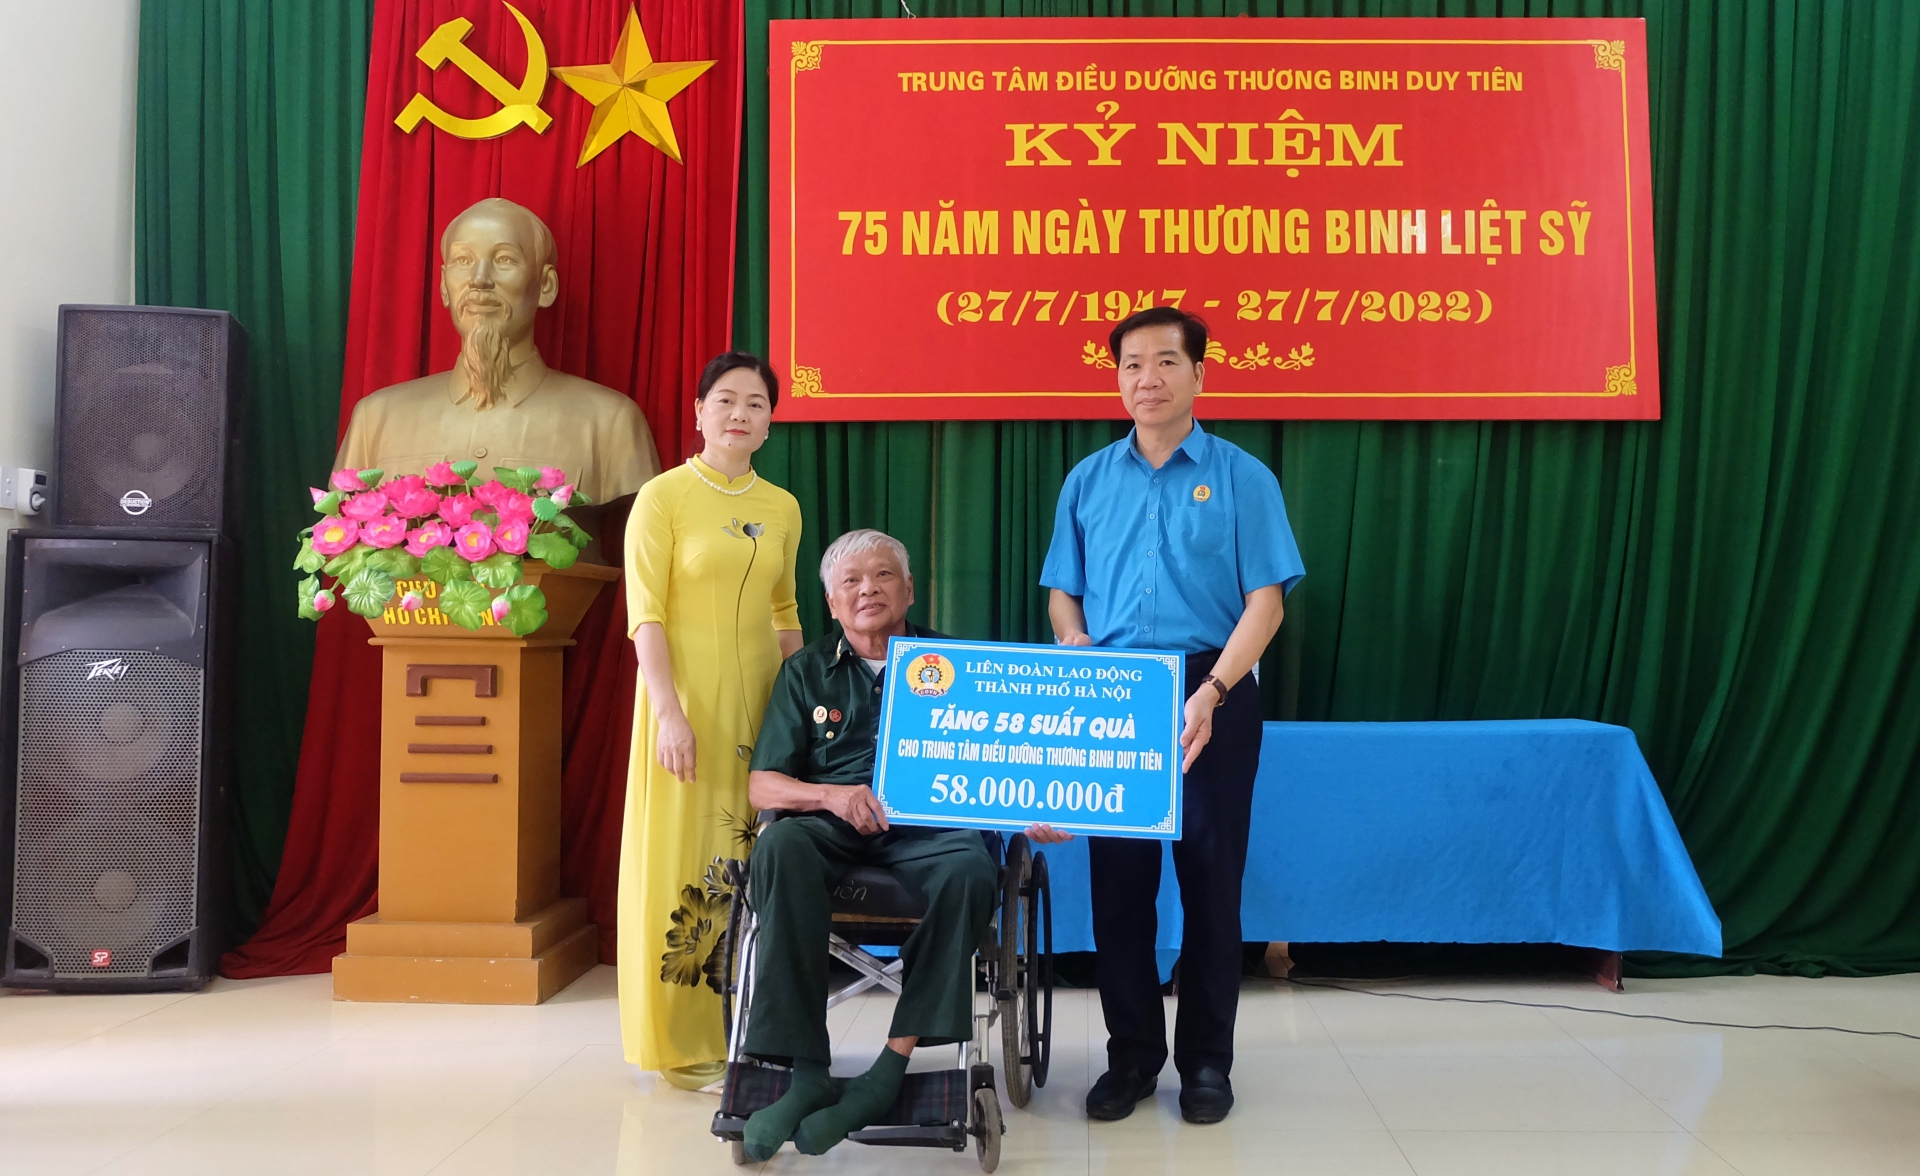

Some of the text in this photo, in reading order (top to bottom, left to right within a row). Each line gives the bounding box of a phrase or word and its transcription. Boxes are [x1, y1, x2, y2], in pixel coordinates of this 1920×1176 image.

[898, 65, 1523, 93] TRUNG TÂM ĐIỀU DƯỠNG THƯƠNG BINH DUY TIÊN
[1004, 101, 1404, 178] KỶ NIỆM
[838, 198, 1592, 266] 75 NĂM NGÀY THƯƠNG BINH LIỆT SỸ
[1236, 287, 1493, 326] 27/7/2022)
[965, 659, 1143, 683] LIÊN ĐOÀN LAO ĐỘNG
[974, 679, 1132, 702] THÀNH PHỐ HÀ NỘI
[929, 703, 1136, 740] TẶNG 58 SUẤT QUÀ
[897, 738, 1163, 771] CHO TRUNG TÂM ĐIỀU DƯỠNG THƯƠNG BINH DUY TIÊN
[929, 773, 1125, 813] 58.000.000đ
[93, 951, 109, 963] SP
